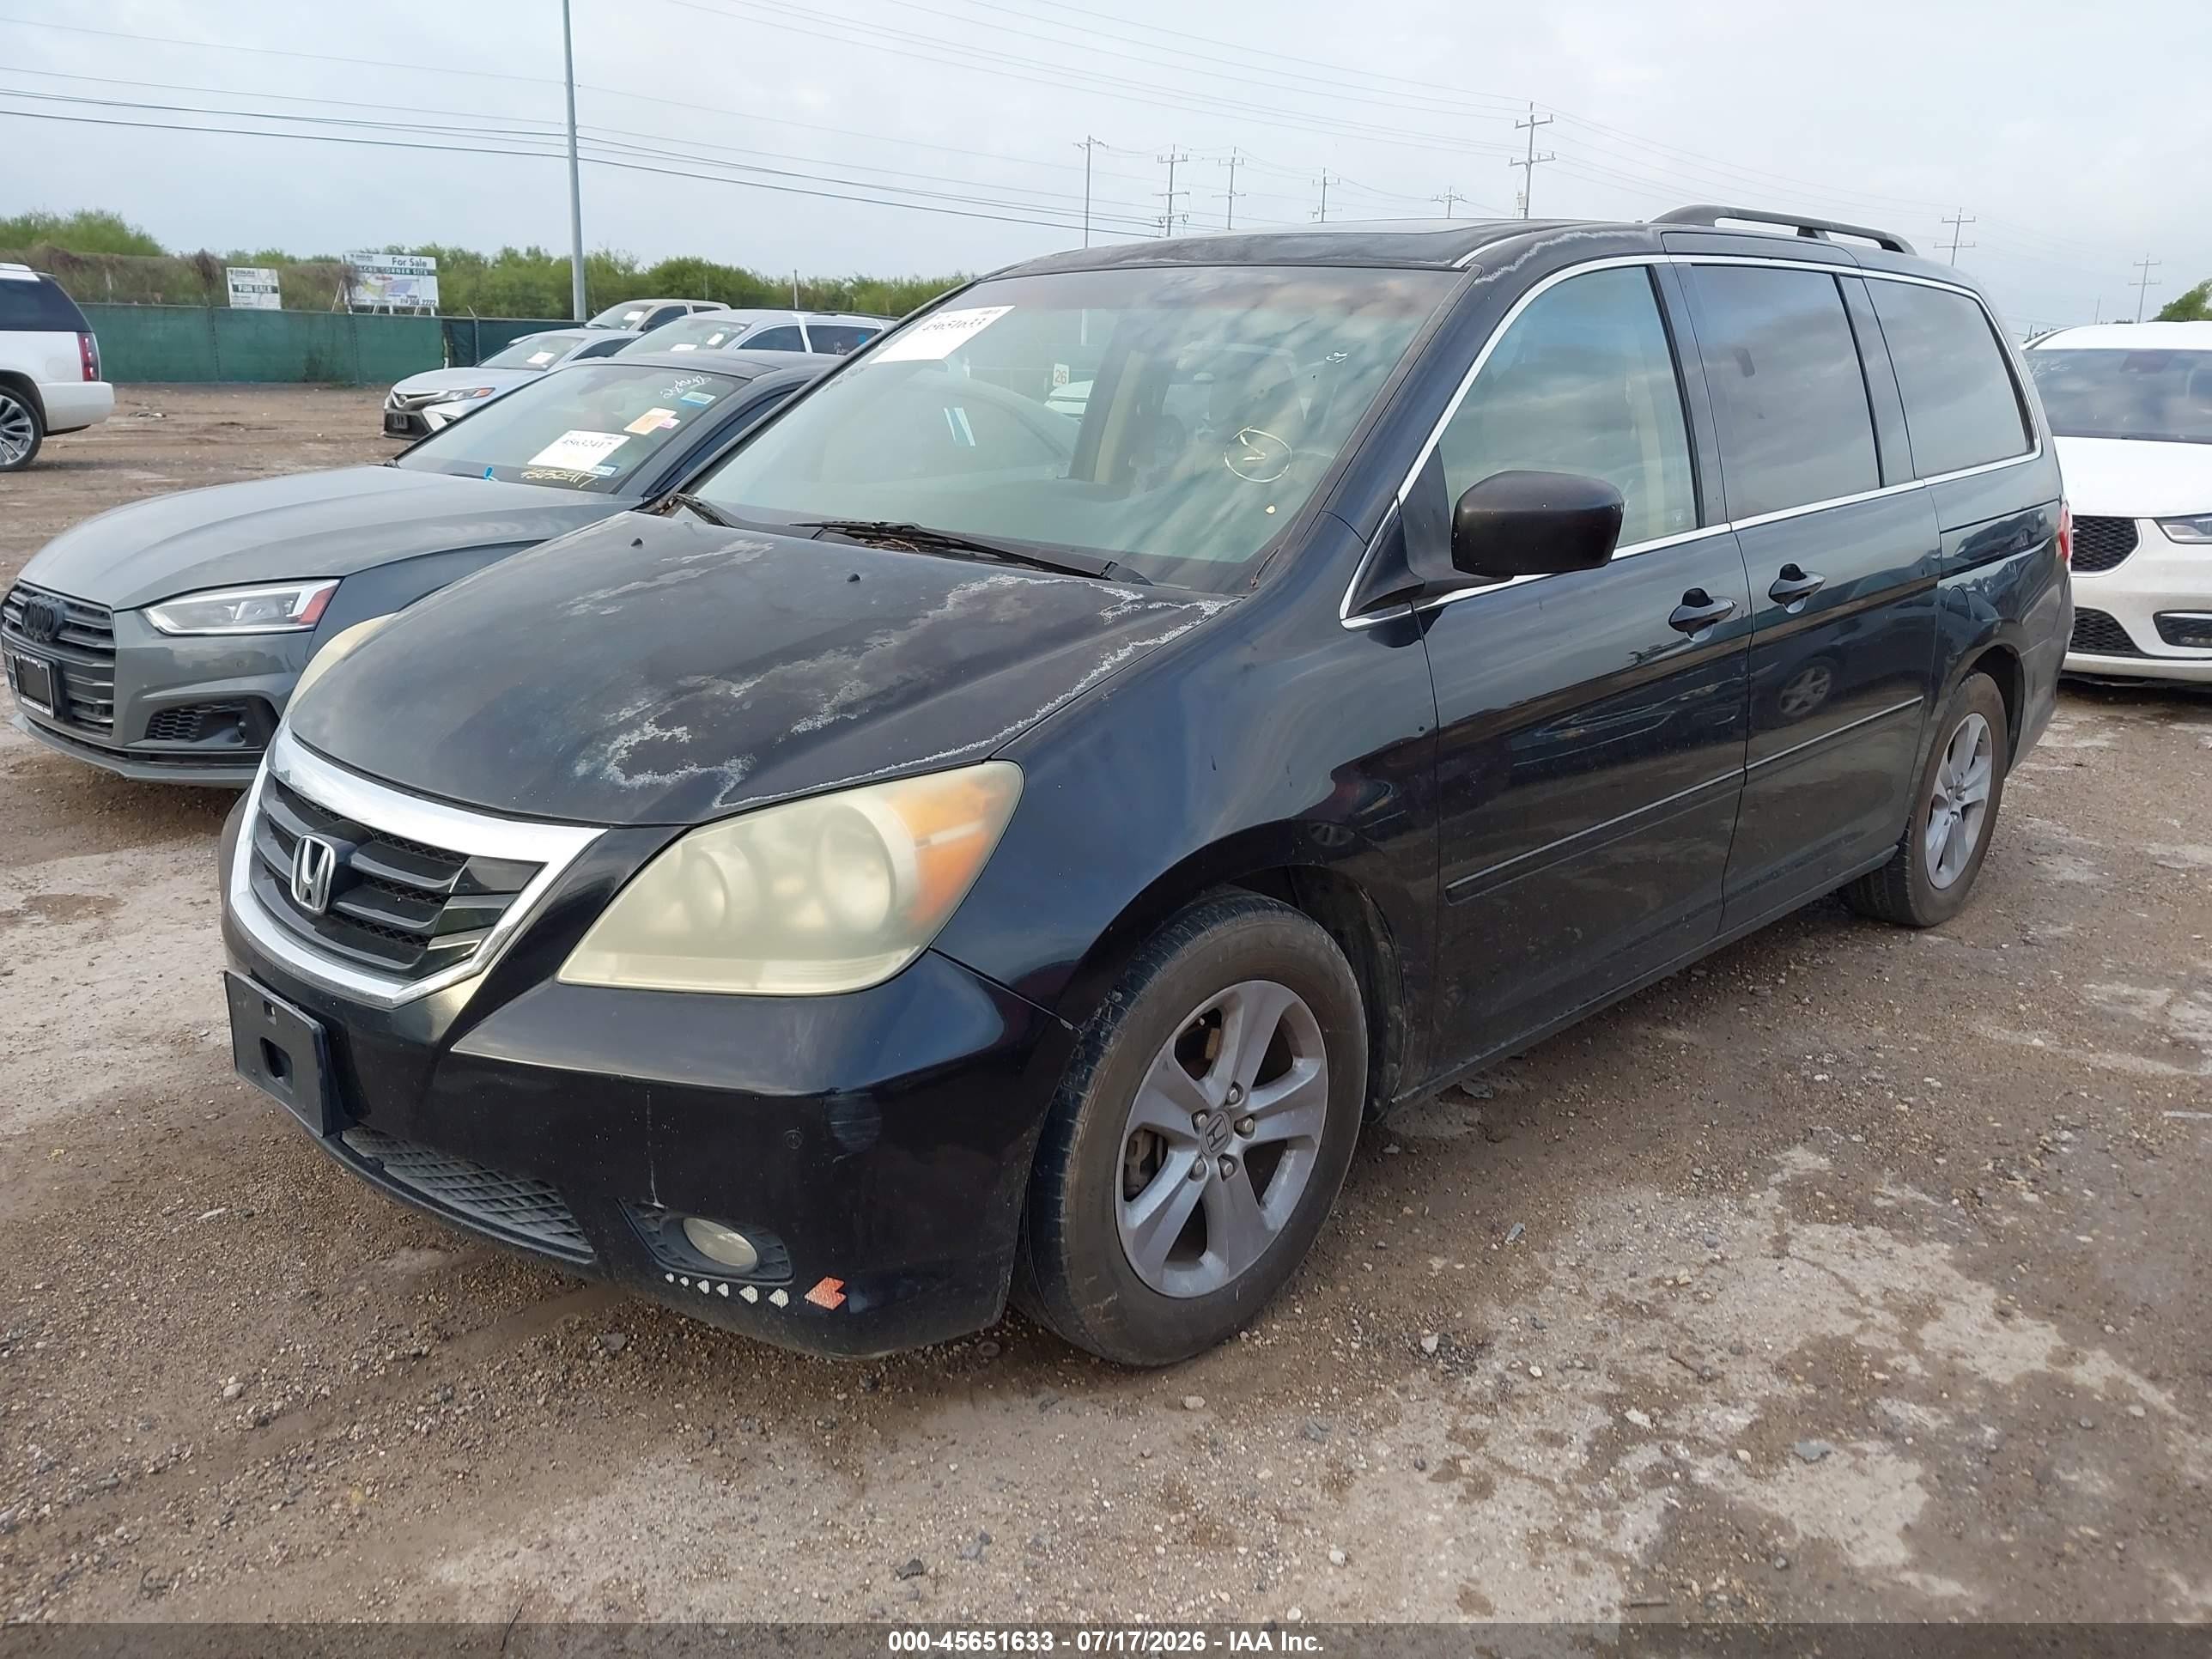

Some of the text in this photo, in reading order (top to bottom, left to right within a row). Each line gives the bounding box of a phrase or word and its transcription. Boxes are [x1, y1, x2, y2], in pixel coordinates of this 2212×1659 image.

[392, 257, 428, 268] For Sale
[1054, 369, 1067, 384] 26
